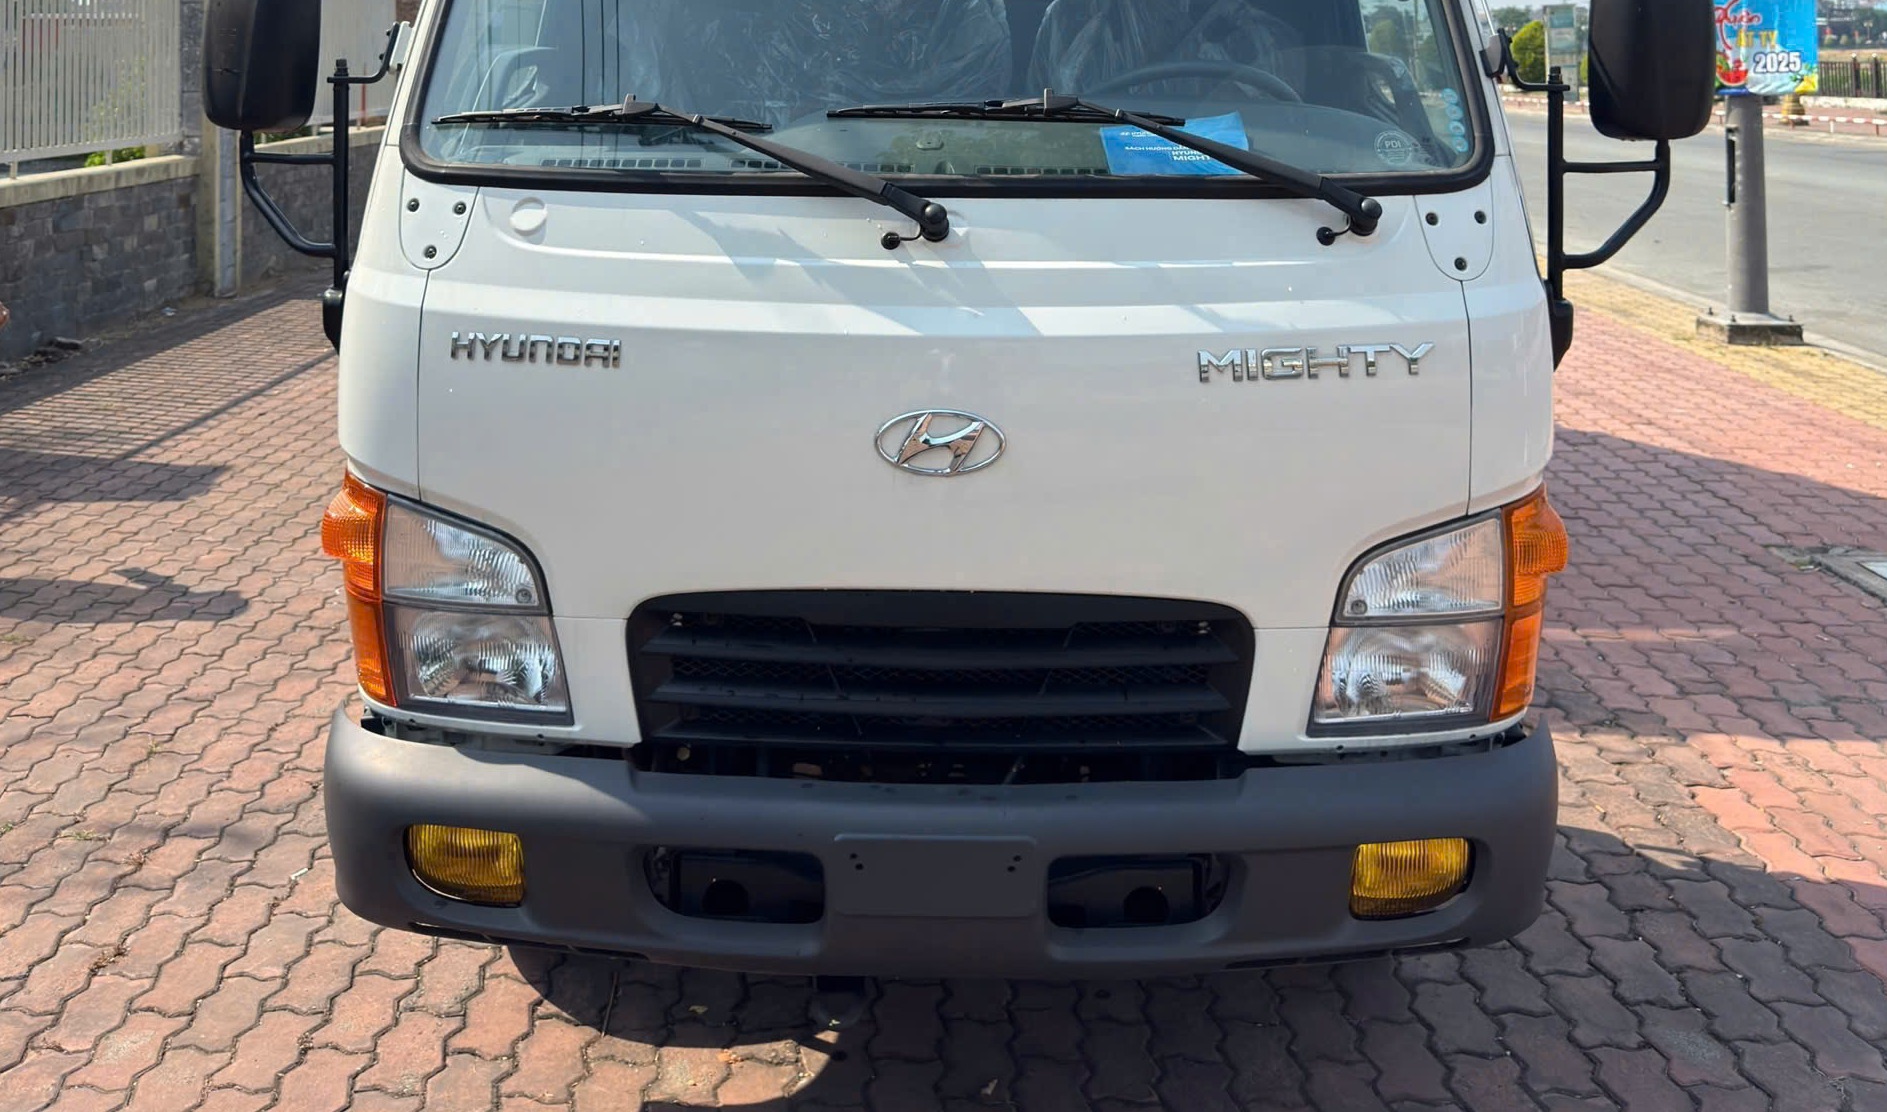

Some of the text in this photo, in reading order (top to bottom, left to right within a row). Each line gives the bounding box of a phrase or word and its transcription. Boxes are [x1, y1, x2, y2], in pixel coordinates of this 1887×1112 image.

[1753, 51, 1803, 74] 2025
[450, 331, 622, 369] HYUNDAI
[1198, 342, 1435, 383] MIGHTY
